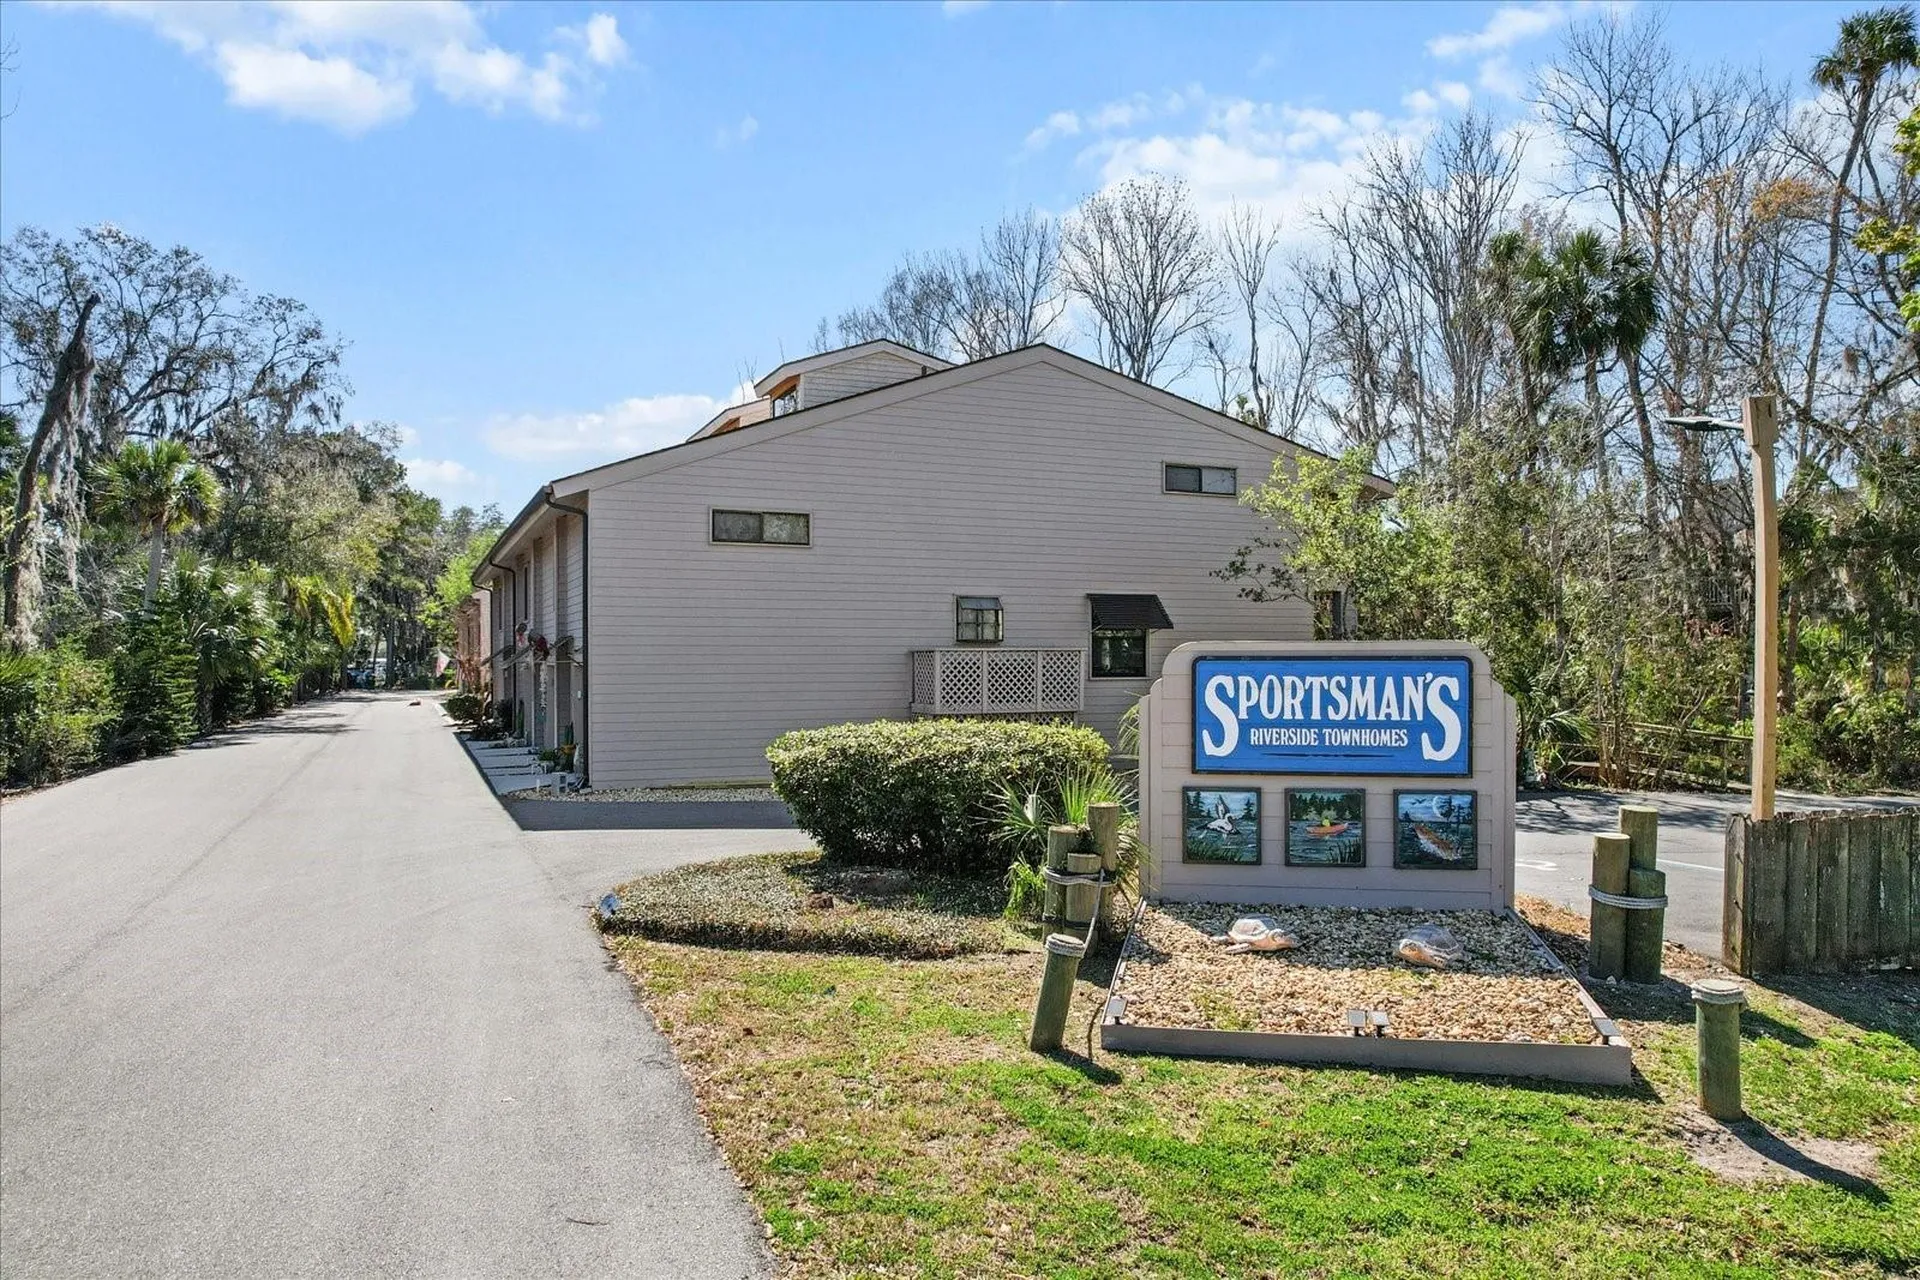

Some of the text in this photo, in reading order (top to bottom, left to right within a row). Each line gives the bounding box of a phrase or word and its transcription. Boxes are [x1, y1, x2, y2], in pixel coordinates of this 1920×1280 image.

[1202, 672, 1461, 761] SPORTSMAN'S
[1250, 728, 1409, 747] RIVERSIDE TOWNHOMES
